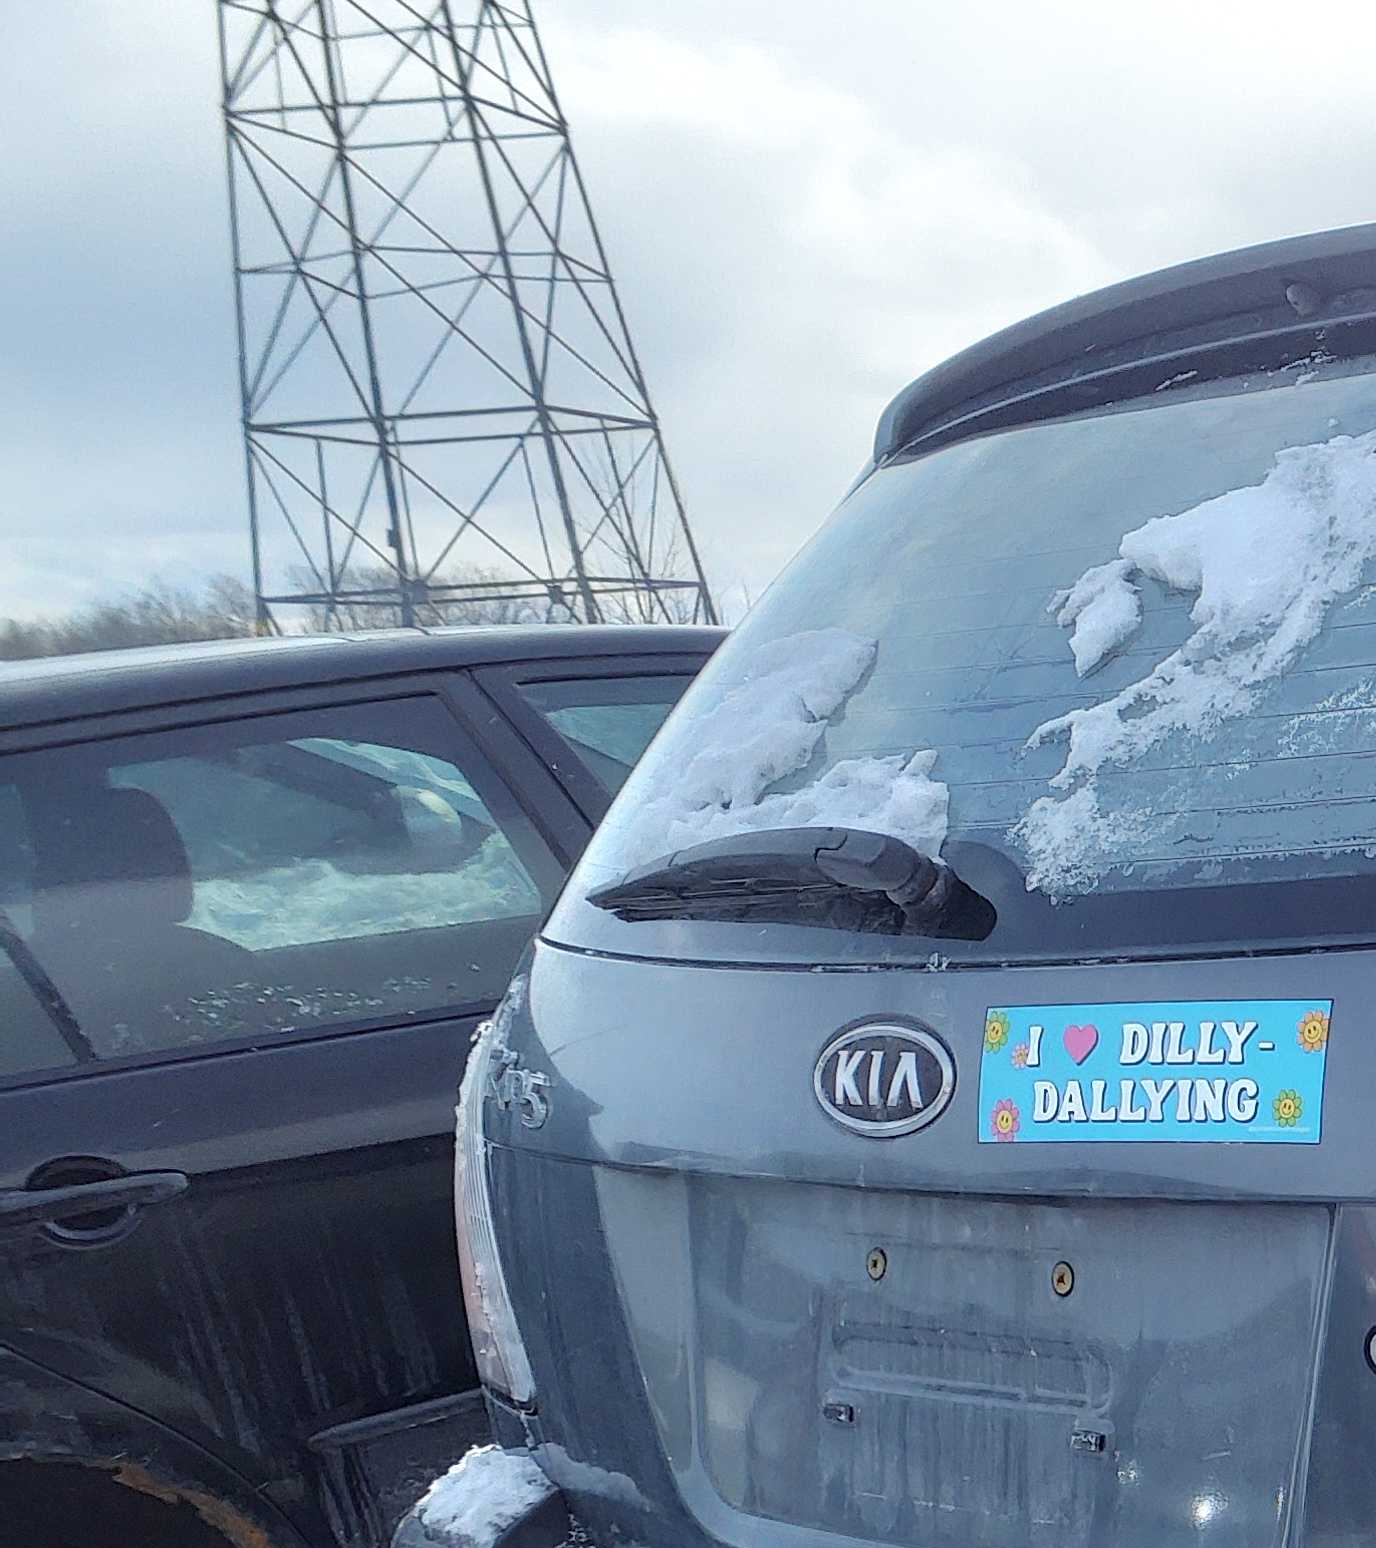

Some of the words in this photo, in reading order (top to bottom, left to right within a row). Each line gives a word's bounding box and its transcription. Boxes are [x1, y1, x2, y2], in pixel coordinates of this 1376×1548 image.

[1026, 1025, 1044, 1067] I
[1119, 1021, 1275, 1066] DILLY-
[835, 1050, 924, 1109] KIA
[1032, 1078, 1260, 1124] DALLYING
